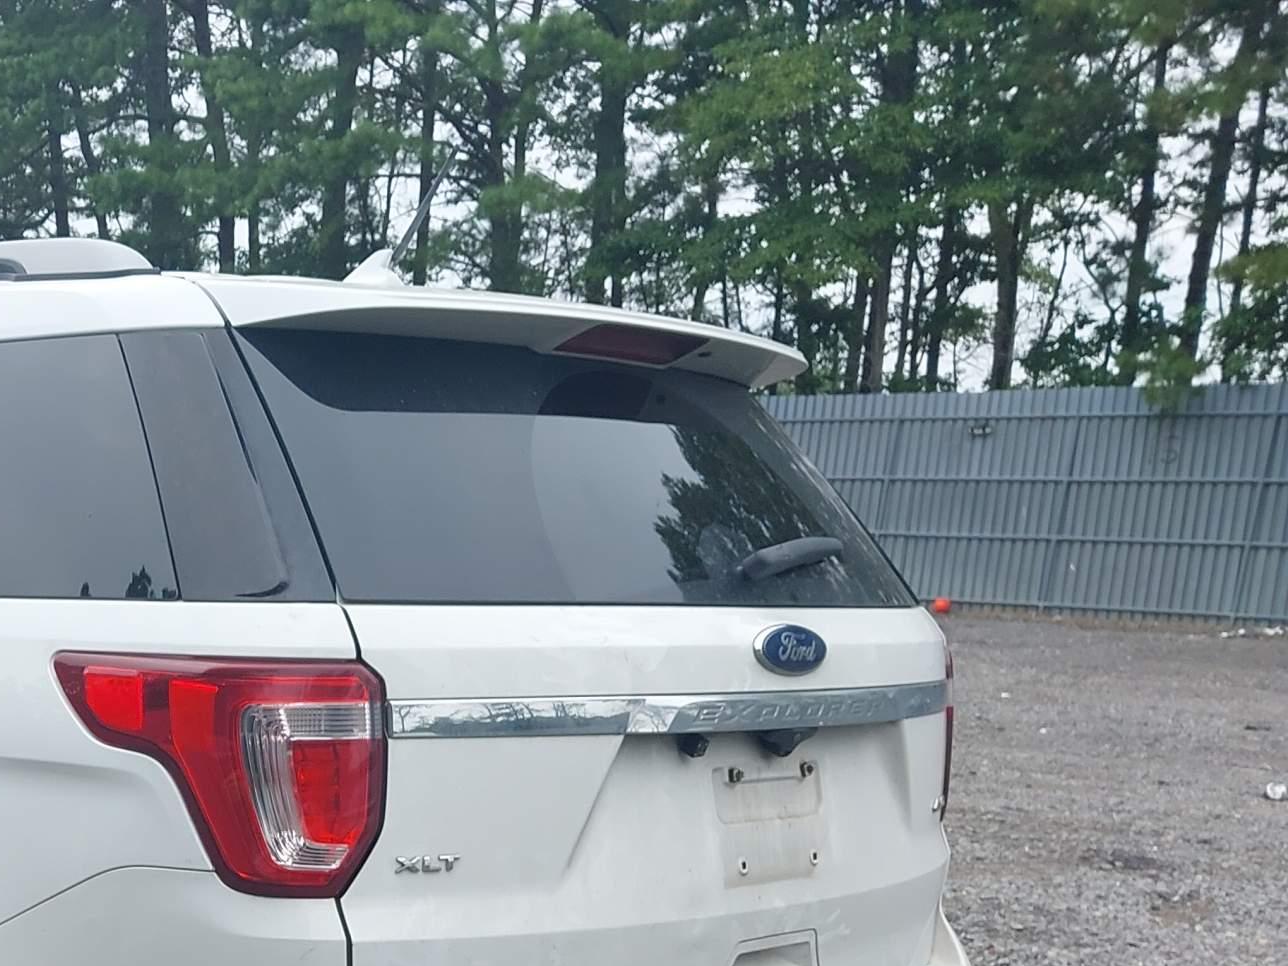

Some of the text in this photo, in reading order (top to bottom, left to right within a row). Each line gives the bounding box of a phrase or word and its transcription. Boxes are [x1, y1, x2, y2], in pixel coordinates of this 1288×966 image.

[778, 631, 817, 662] Ford
[696, 692, 886, 723] EXPLORER
[394, 854, 460, 874] XLT
